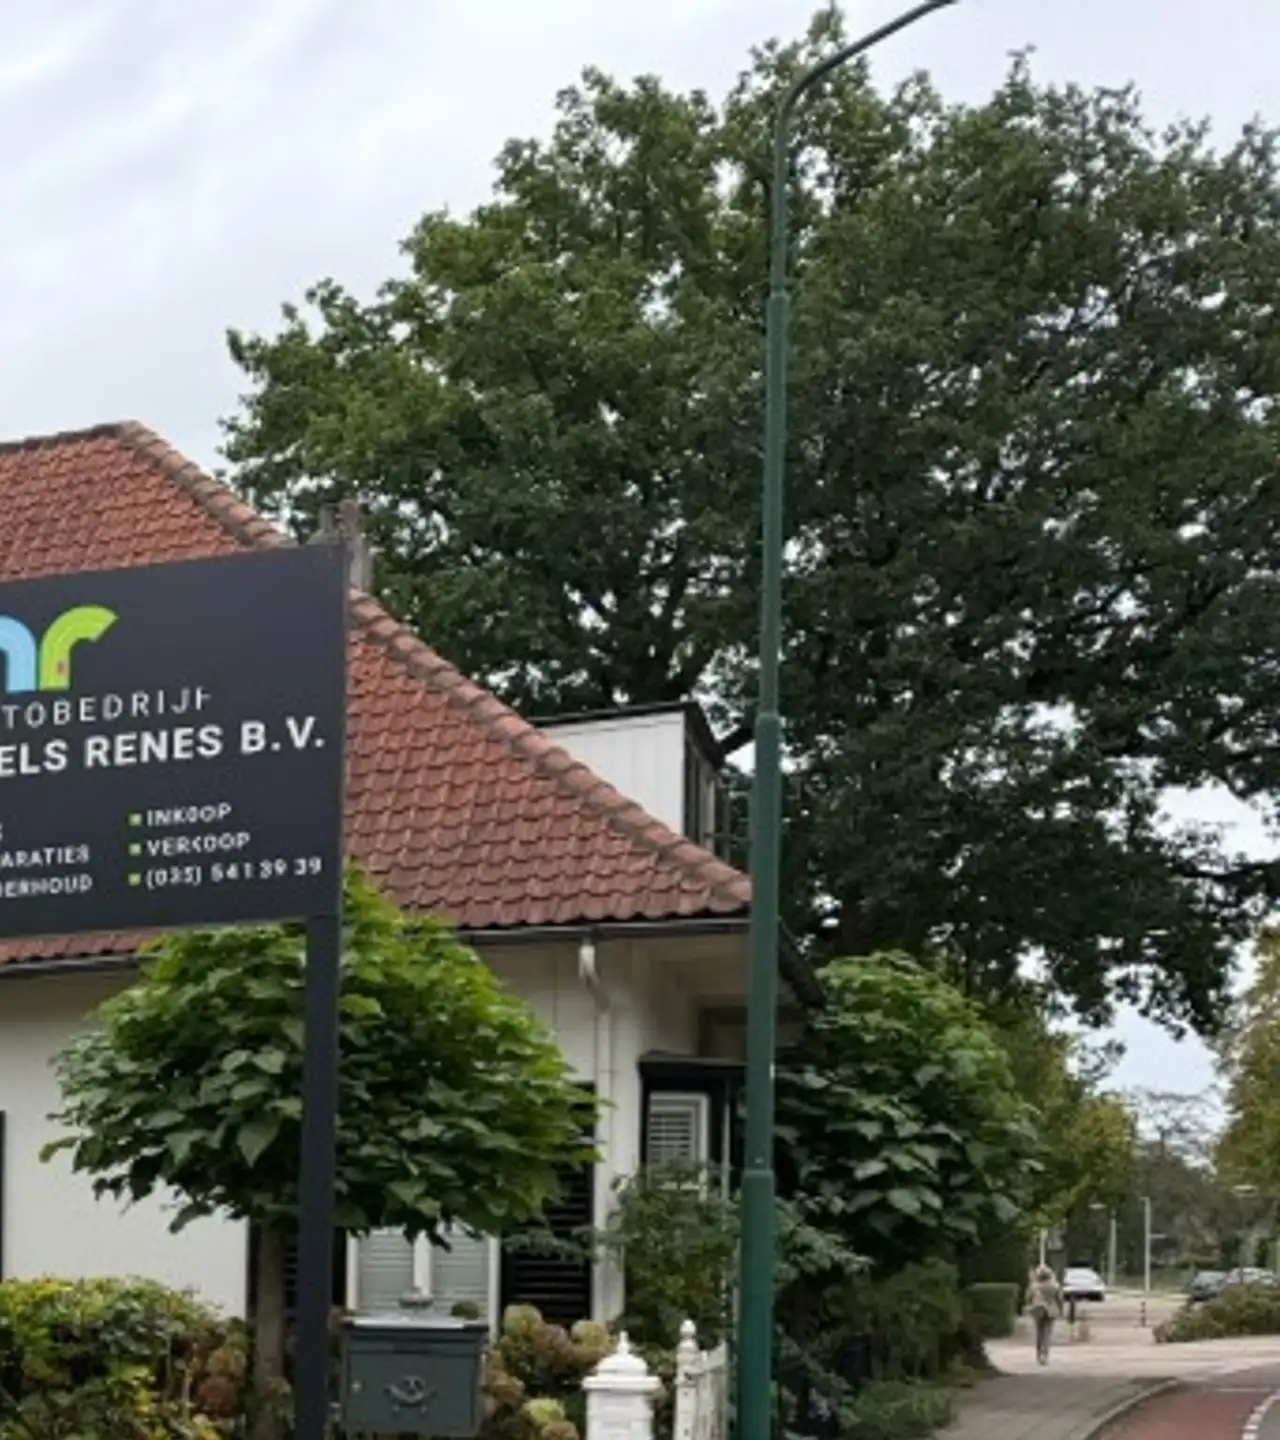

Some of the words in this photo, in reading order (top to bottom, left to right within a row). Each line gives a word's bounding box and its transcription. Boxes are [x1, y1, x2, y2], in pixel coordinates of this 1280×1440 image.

[84, 724, 224, 769] RENES
[240, 715, 326, 755] B.V.
[147, 802, 232, 827] INKOOP
[147, 831, 251, 857] VERKOOP
